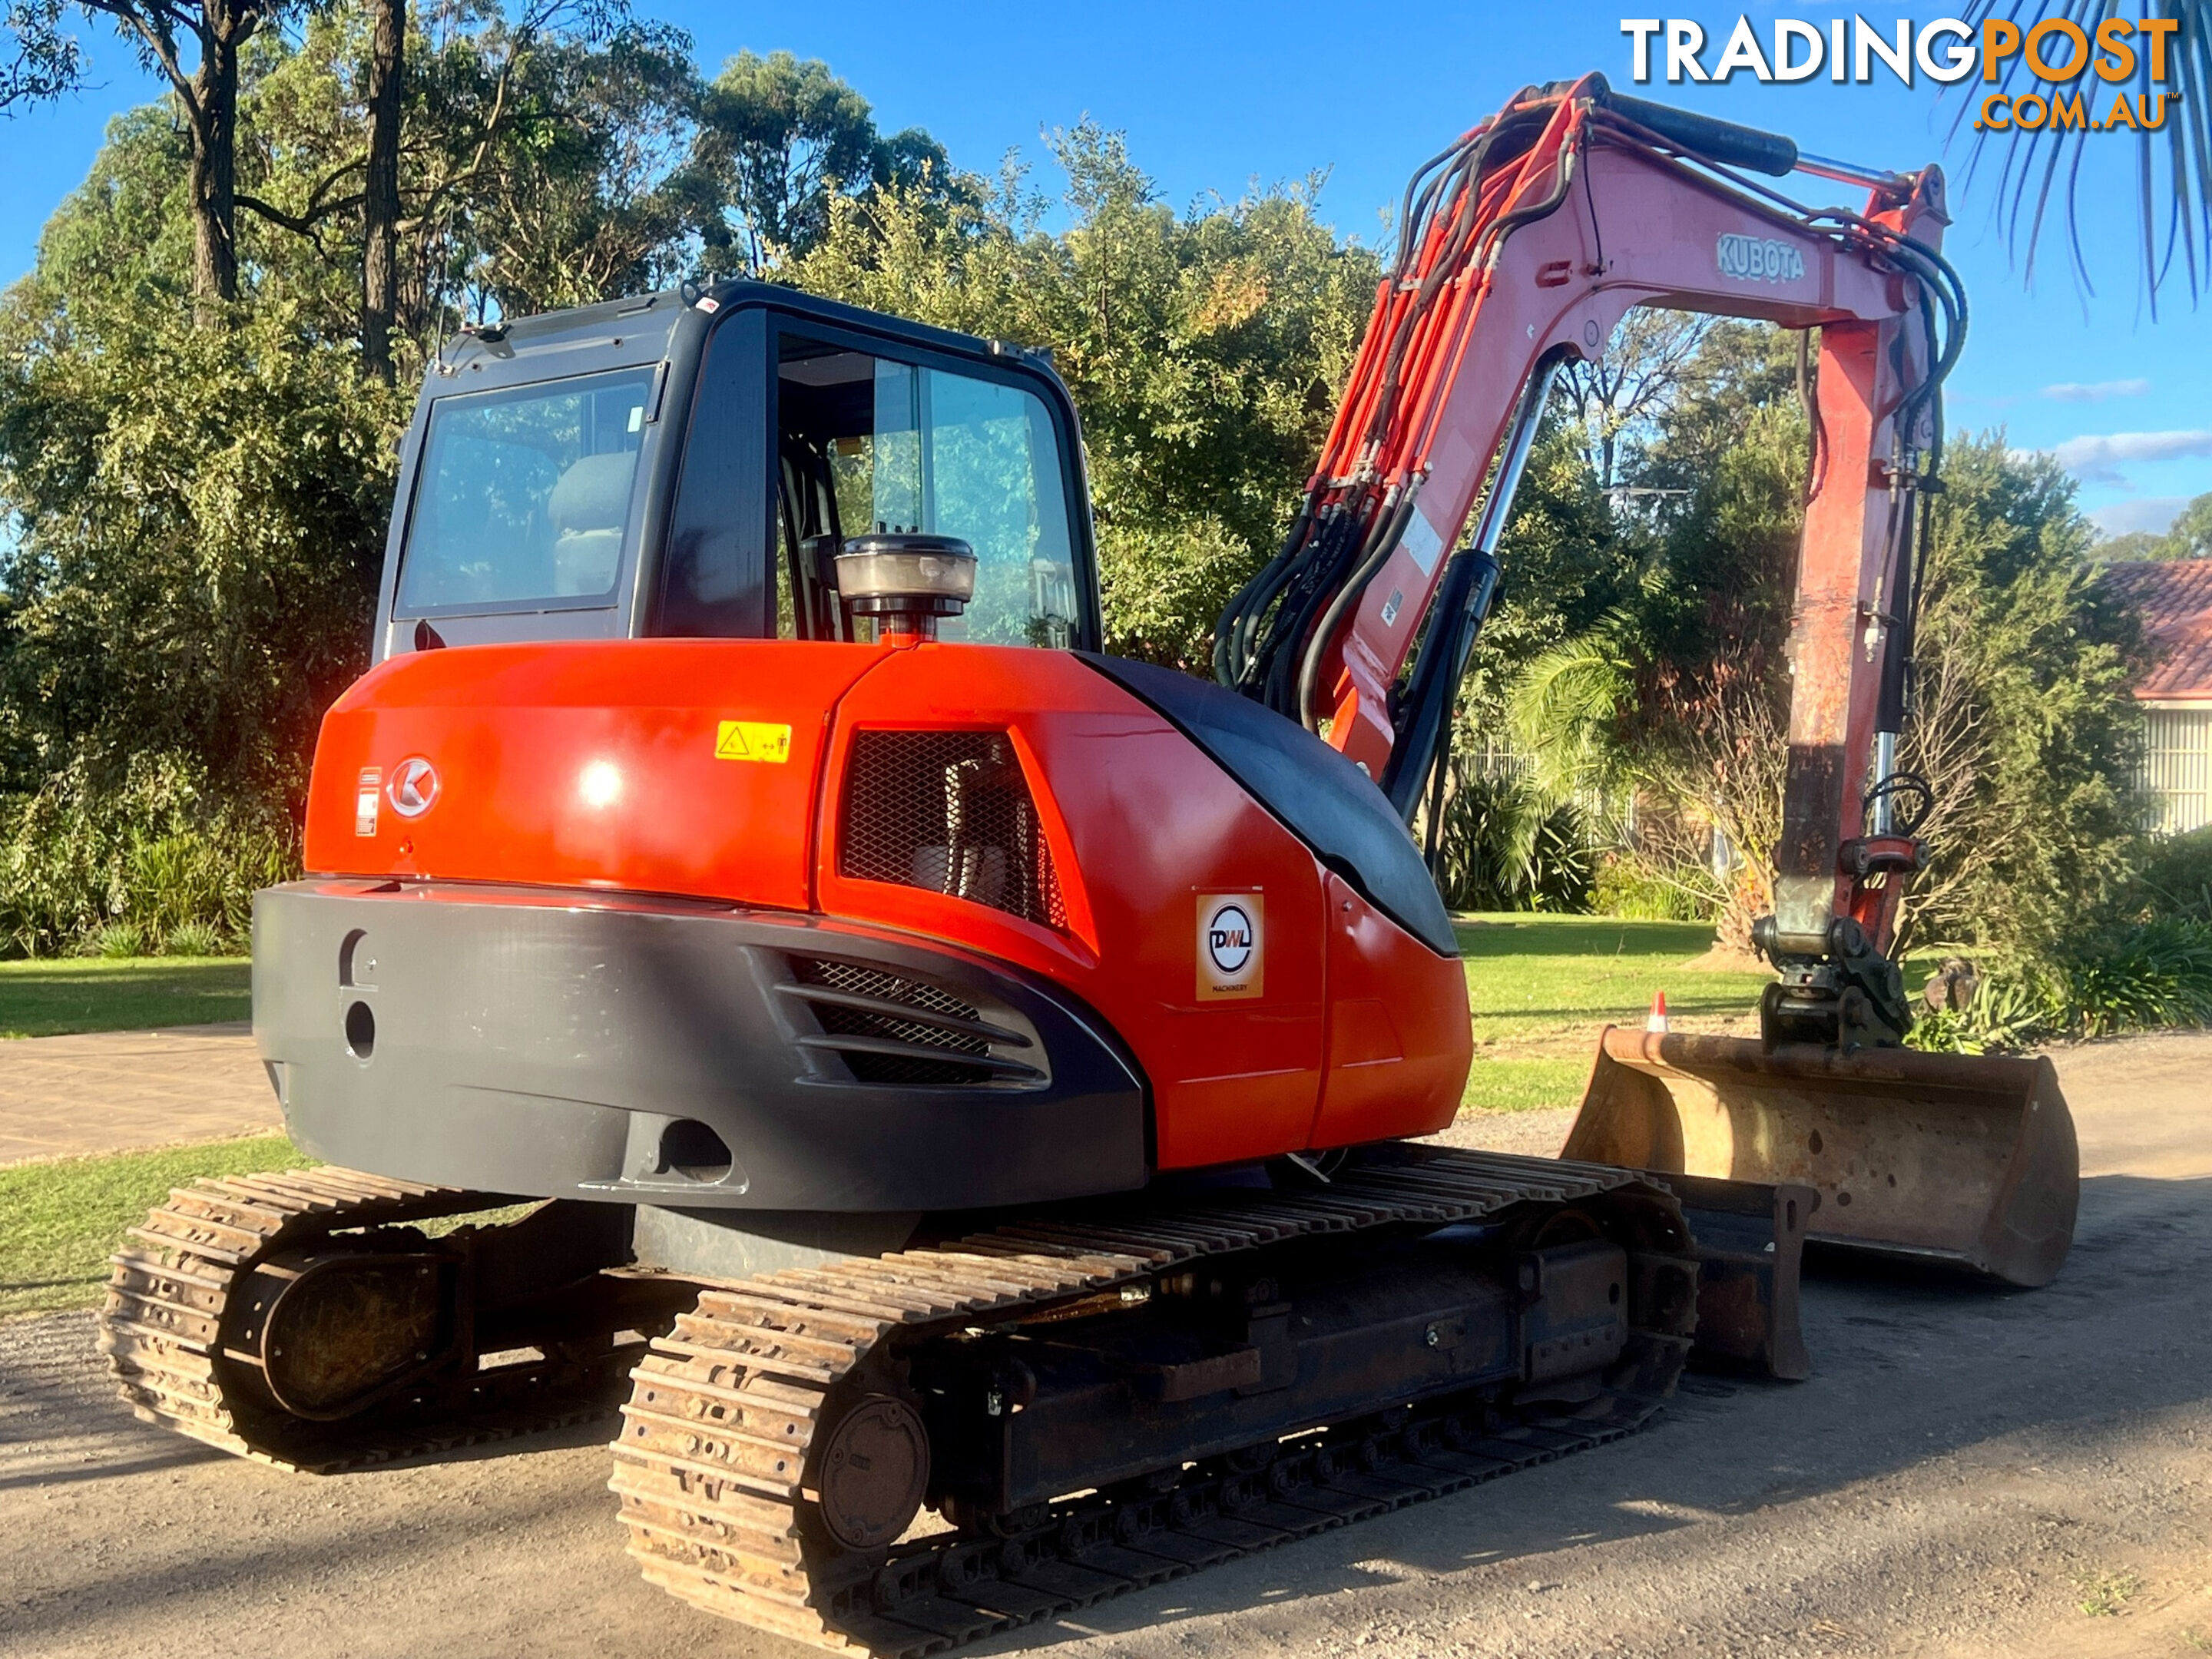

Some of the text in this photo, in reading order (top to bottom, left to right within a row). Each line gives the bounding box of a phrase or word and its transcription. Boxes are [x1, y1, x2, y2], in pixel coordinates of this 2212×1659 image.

[1717, 234, 1804, 280] KUBOTA
[1209, 929, 1252, 949] DWL
[1212, 984, 1248, 993] MACHINERY
